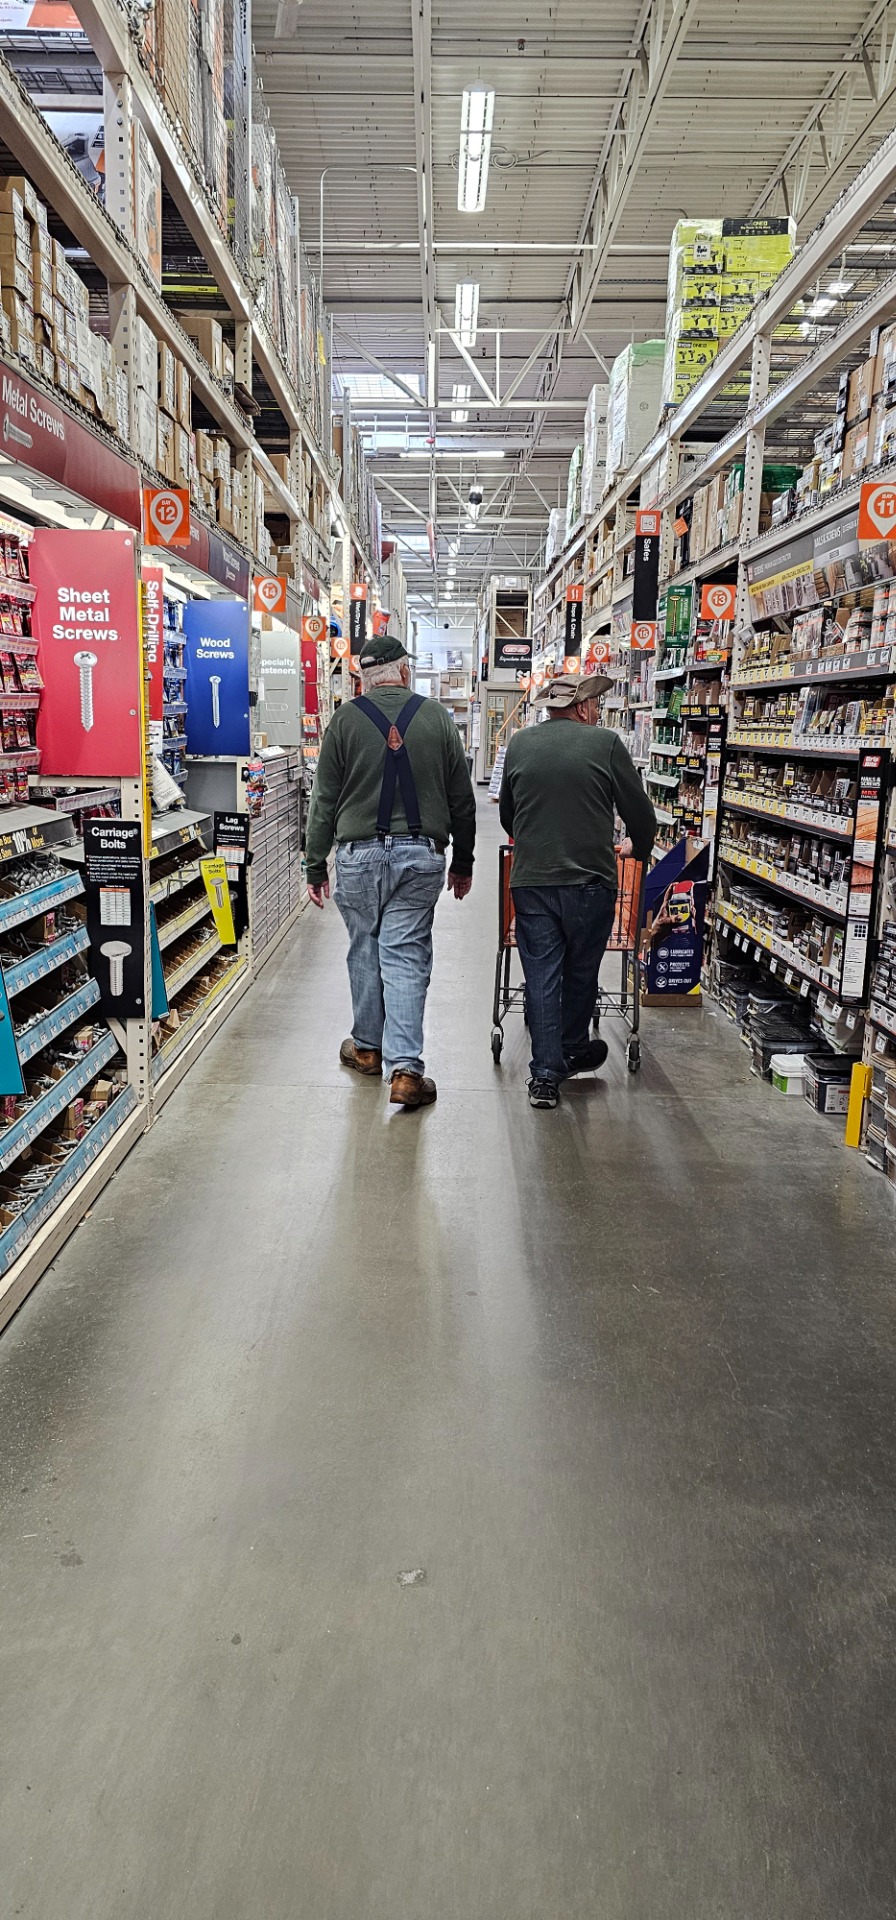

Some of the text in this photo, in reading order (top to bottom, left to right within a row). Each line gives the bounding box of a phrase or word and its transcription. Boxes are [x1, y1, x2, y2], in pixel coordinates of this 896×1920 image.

[2, 374, 65, 441] Metal Screws
[877, 499, 895, 514] 11
[158, 506, 176, 520] 12
[643, 538, 651, 562] Safes
[57, 587, 111, 604] Sheet
[263, 588, 276, 596] 14
[713, 595, 726, 605] 13
[59, 606, 110, 622] Metal
[146, 580, 160, 663] Self-Drilling
[309, 623, 319, 631] 16
[52, 624, 118, 641] Screws
[200, 637, 231, 648] Wood
[196, 648, 235, 659] Screws
[260, 658, 295, 667] pecialty
[260, 667, 297, 675] asteners
[225, 816, 239, 825] Lag
[91, 826, 134, 840] Carriage
[219, 823, 245, 832] Screws
[12, 828, 32, 854] 10%
[100, 838, 127, 849] Bolts
[669, 904, 689, 916] WD-40
